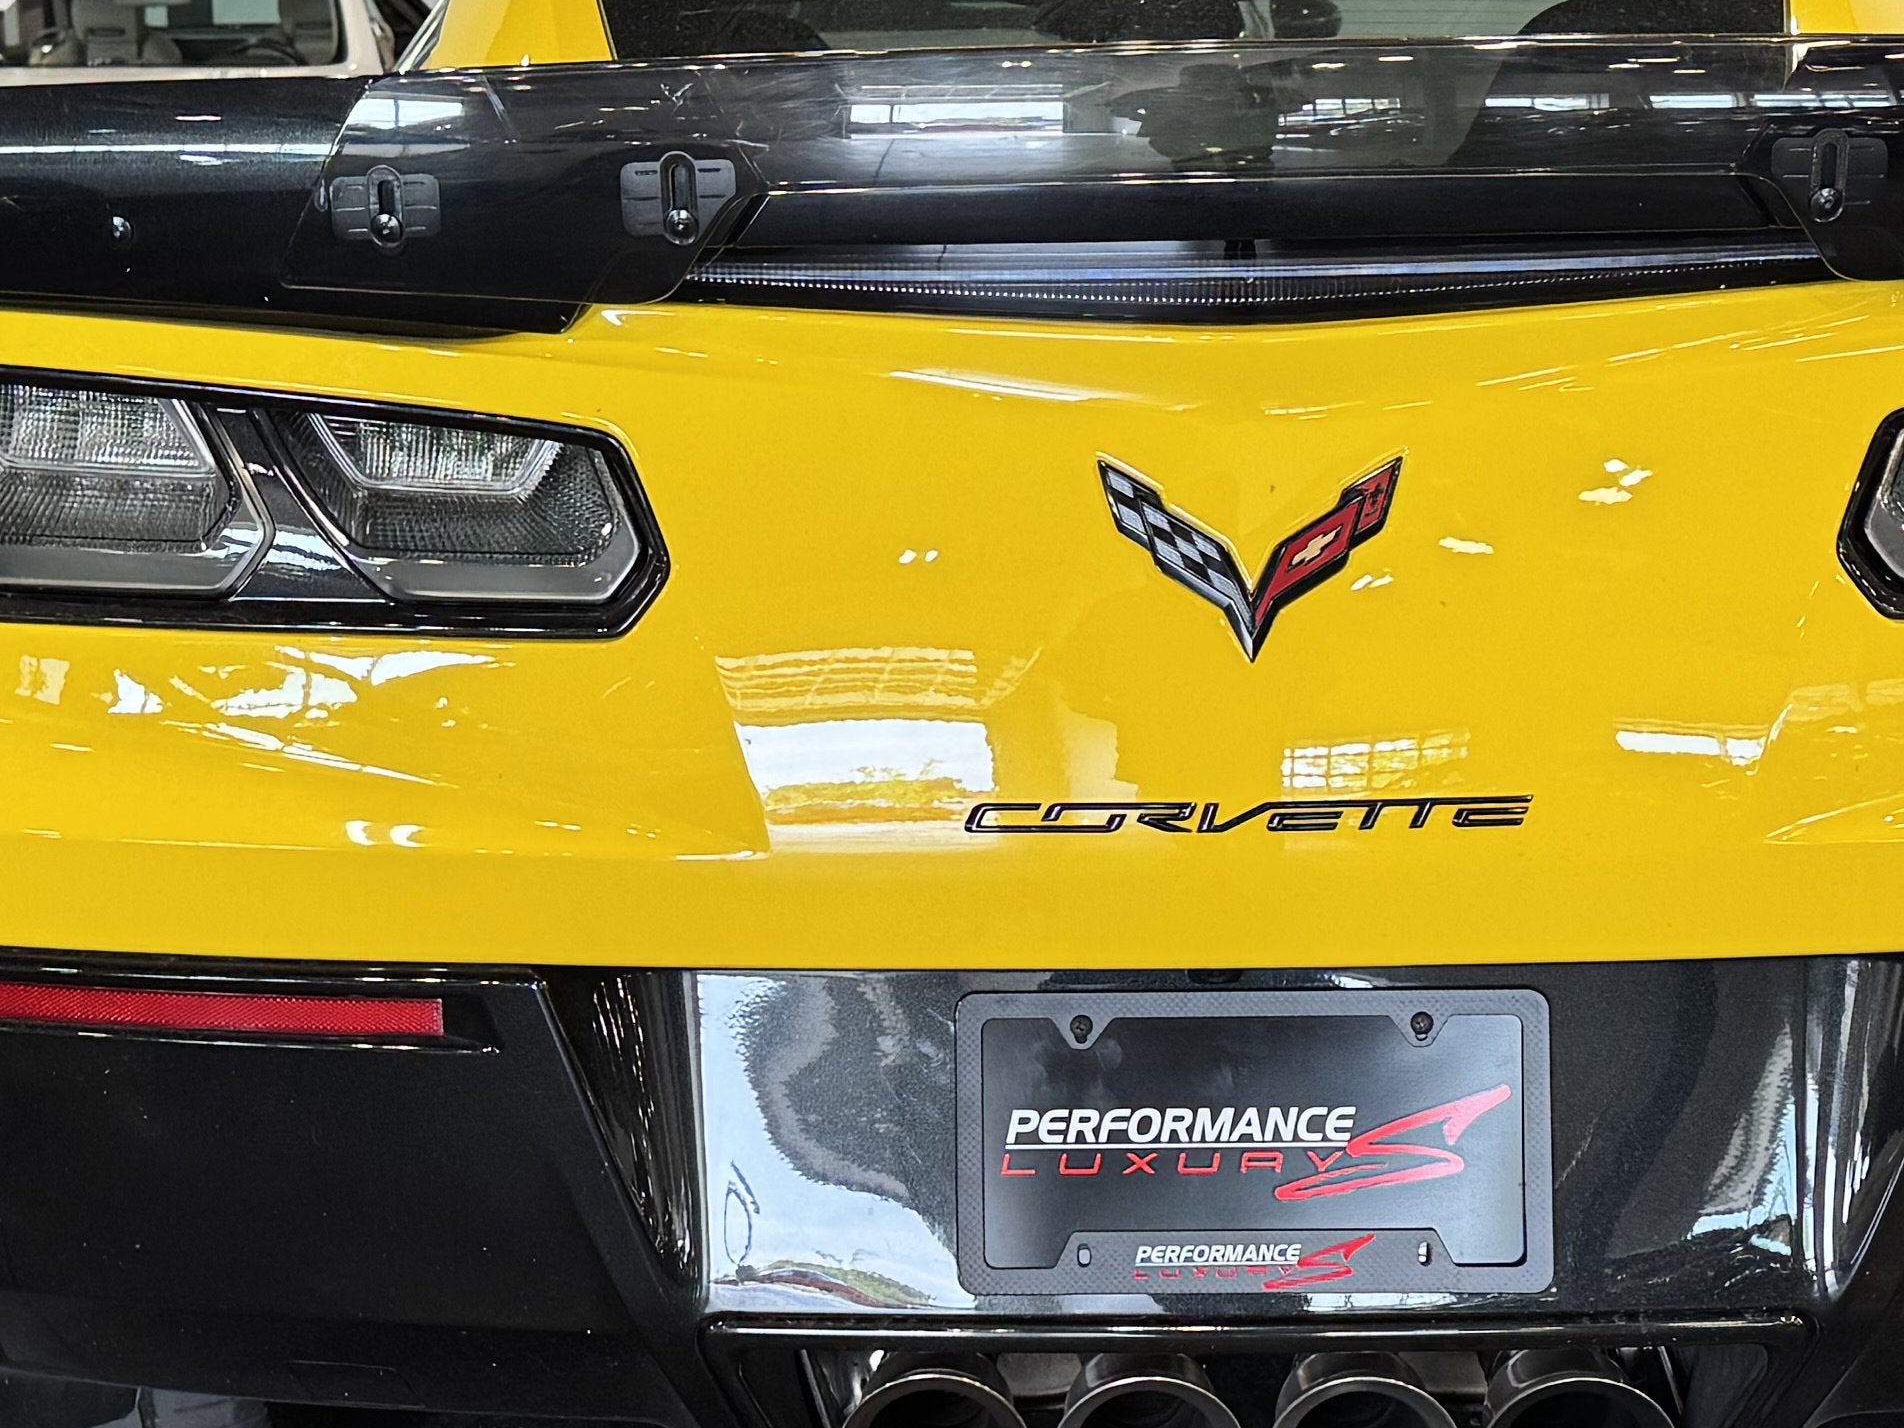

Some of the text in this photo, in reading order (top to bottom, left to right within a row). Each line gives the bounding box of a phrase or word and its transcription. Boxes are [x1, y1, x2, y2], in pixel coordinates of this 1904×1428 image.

[964, 795, 1534, 833] CORVETTE
[1006, 1107, 1356, 1143] PERFORMANCE
[1001, 1151, 1346, 1175] LUXURY
[1136, 1244, 1302, 1263] PERFORMANCE
